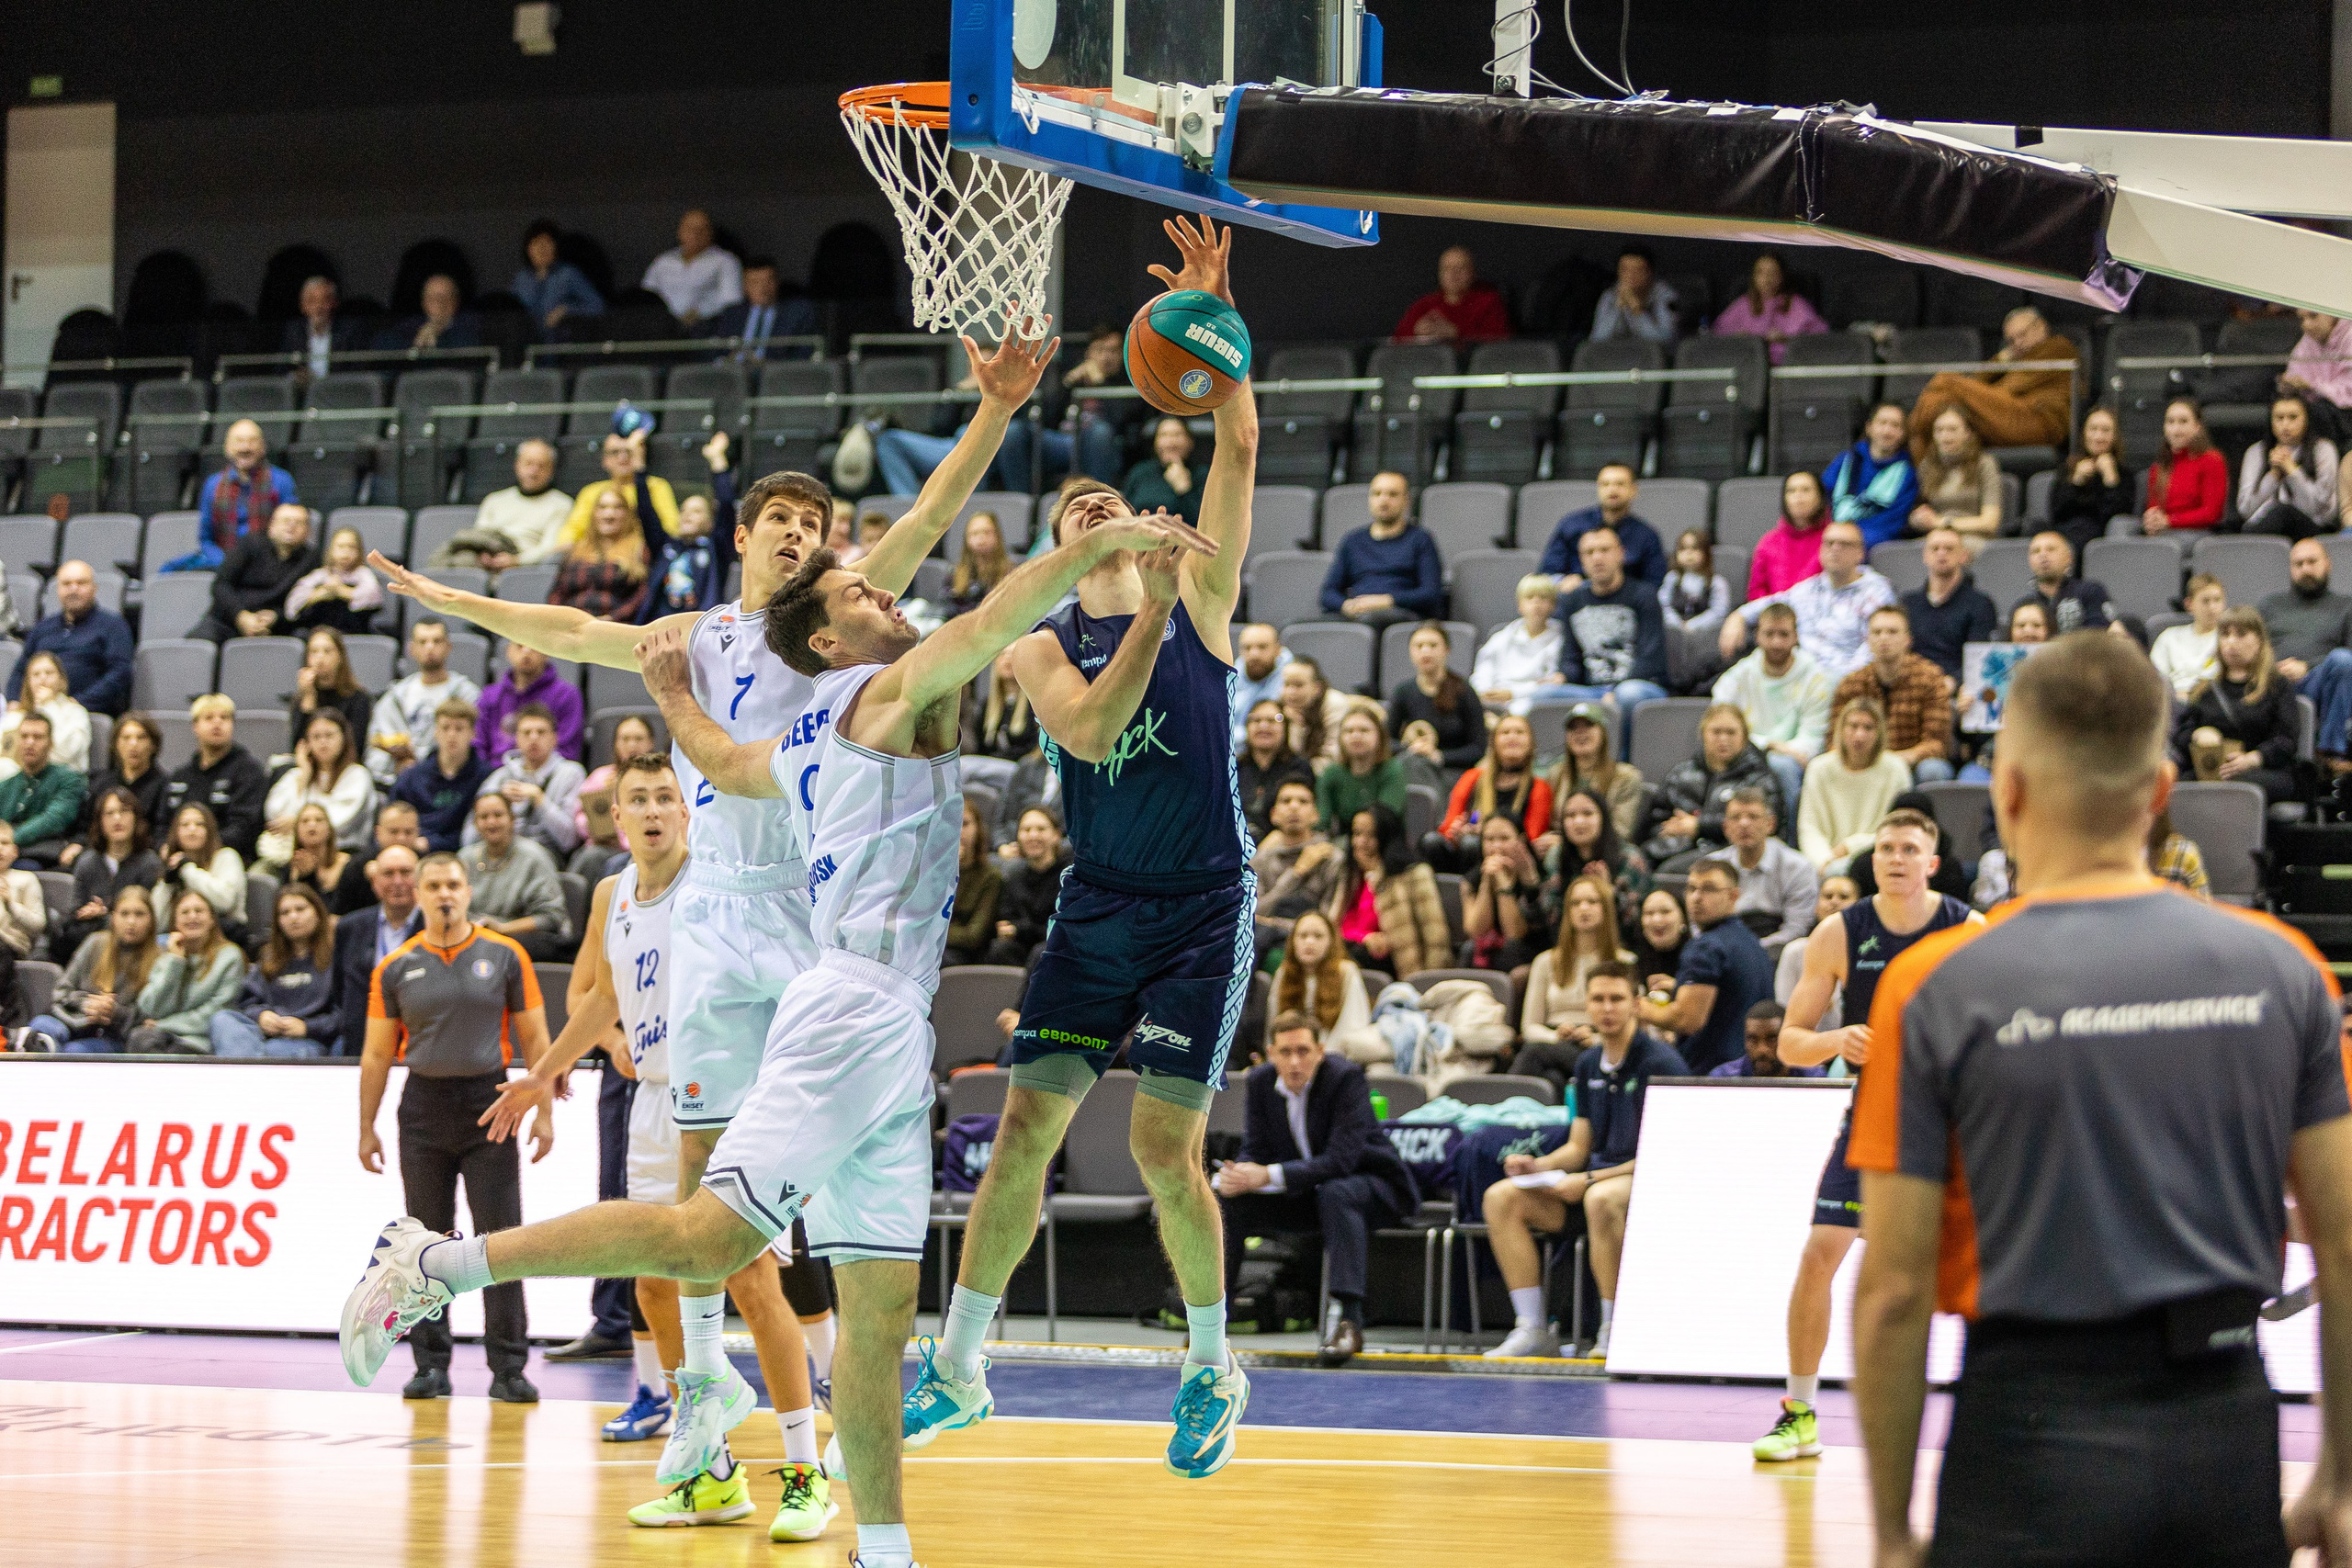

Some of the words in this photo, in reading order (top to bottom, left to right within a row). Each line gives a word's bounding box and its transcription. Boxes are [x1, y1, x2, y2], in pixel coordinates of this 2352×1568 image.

[1185, 322, 1243, 368] SIBUR
[730, 672, 755, 720] 7
[636, 948, 659, 992] 12
[1039, 1028, 1109, 1050] евроопт
[0, 1420, 472, 1449] НЕФТЬ
